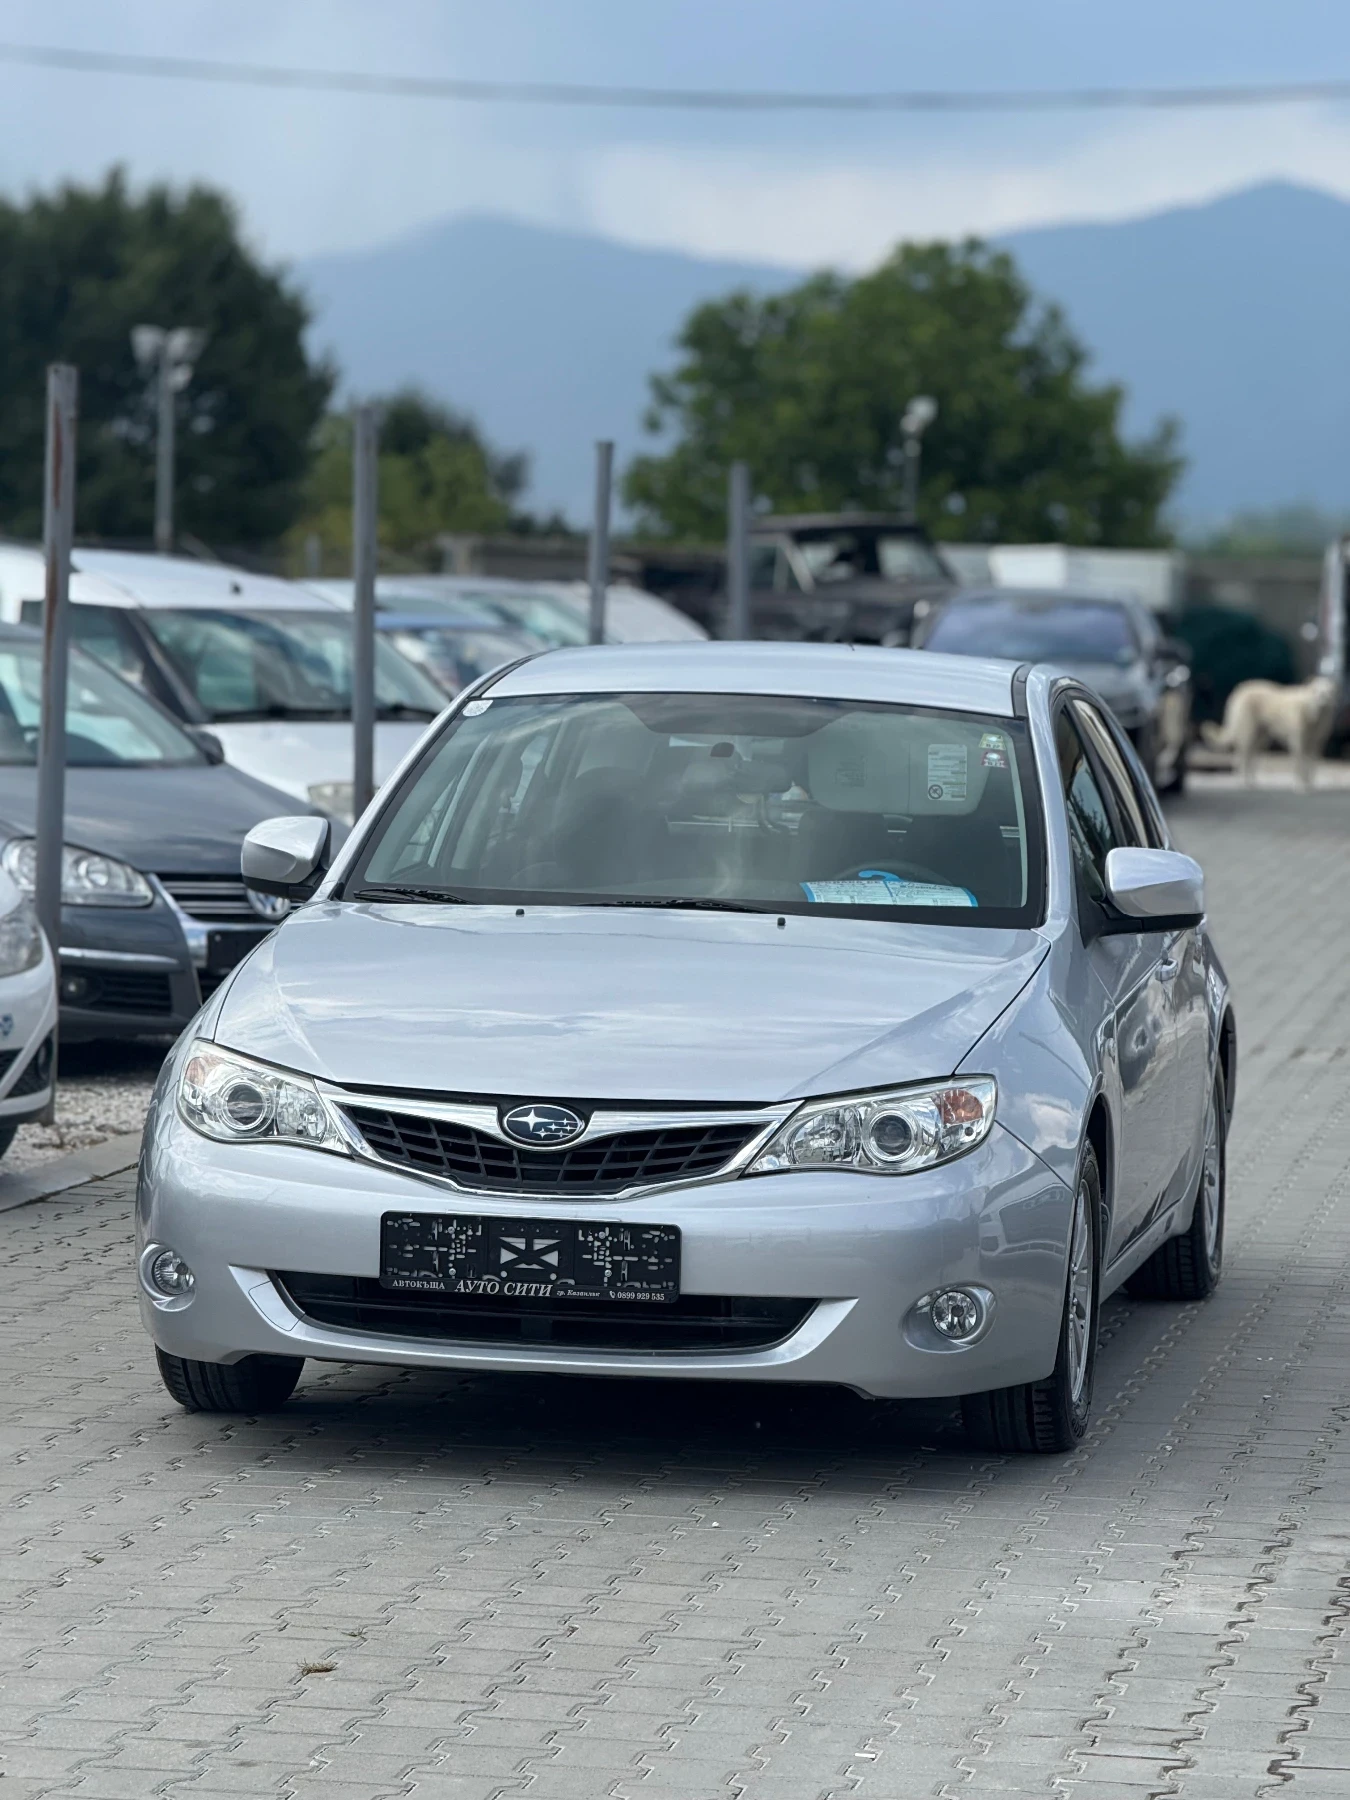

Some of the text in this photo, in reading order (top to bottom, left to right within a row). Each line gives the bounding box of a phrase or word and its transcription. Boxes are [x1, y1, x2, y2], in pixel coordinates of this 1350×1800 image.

[392, 1279, 445, 1290] АВТОКЪЩА
[454, 1279, 500, 1294] АУТО
[503, 1282, 554, 1297] СИТИ
[617, 1291, 635, 1300] 0899
[636, 1292, 650, 1300] 929
[651, 1292, 665, 1301] 535
